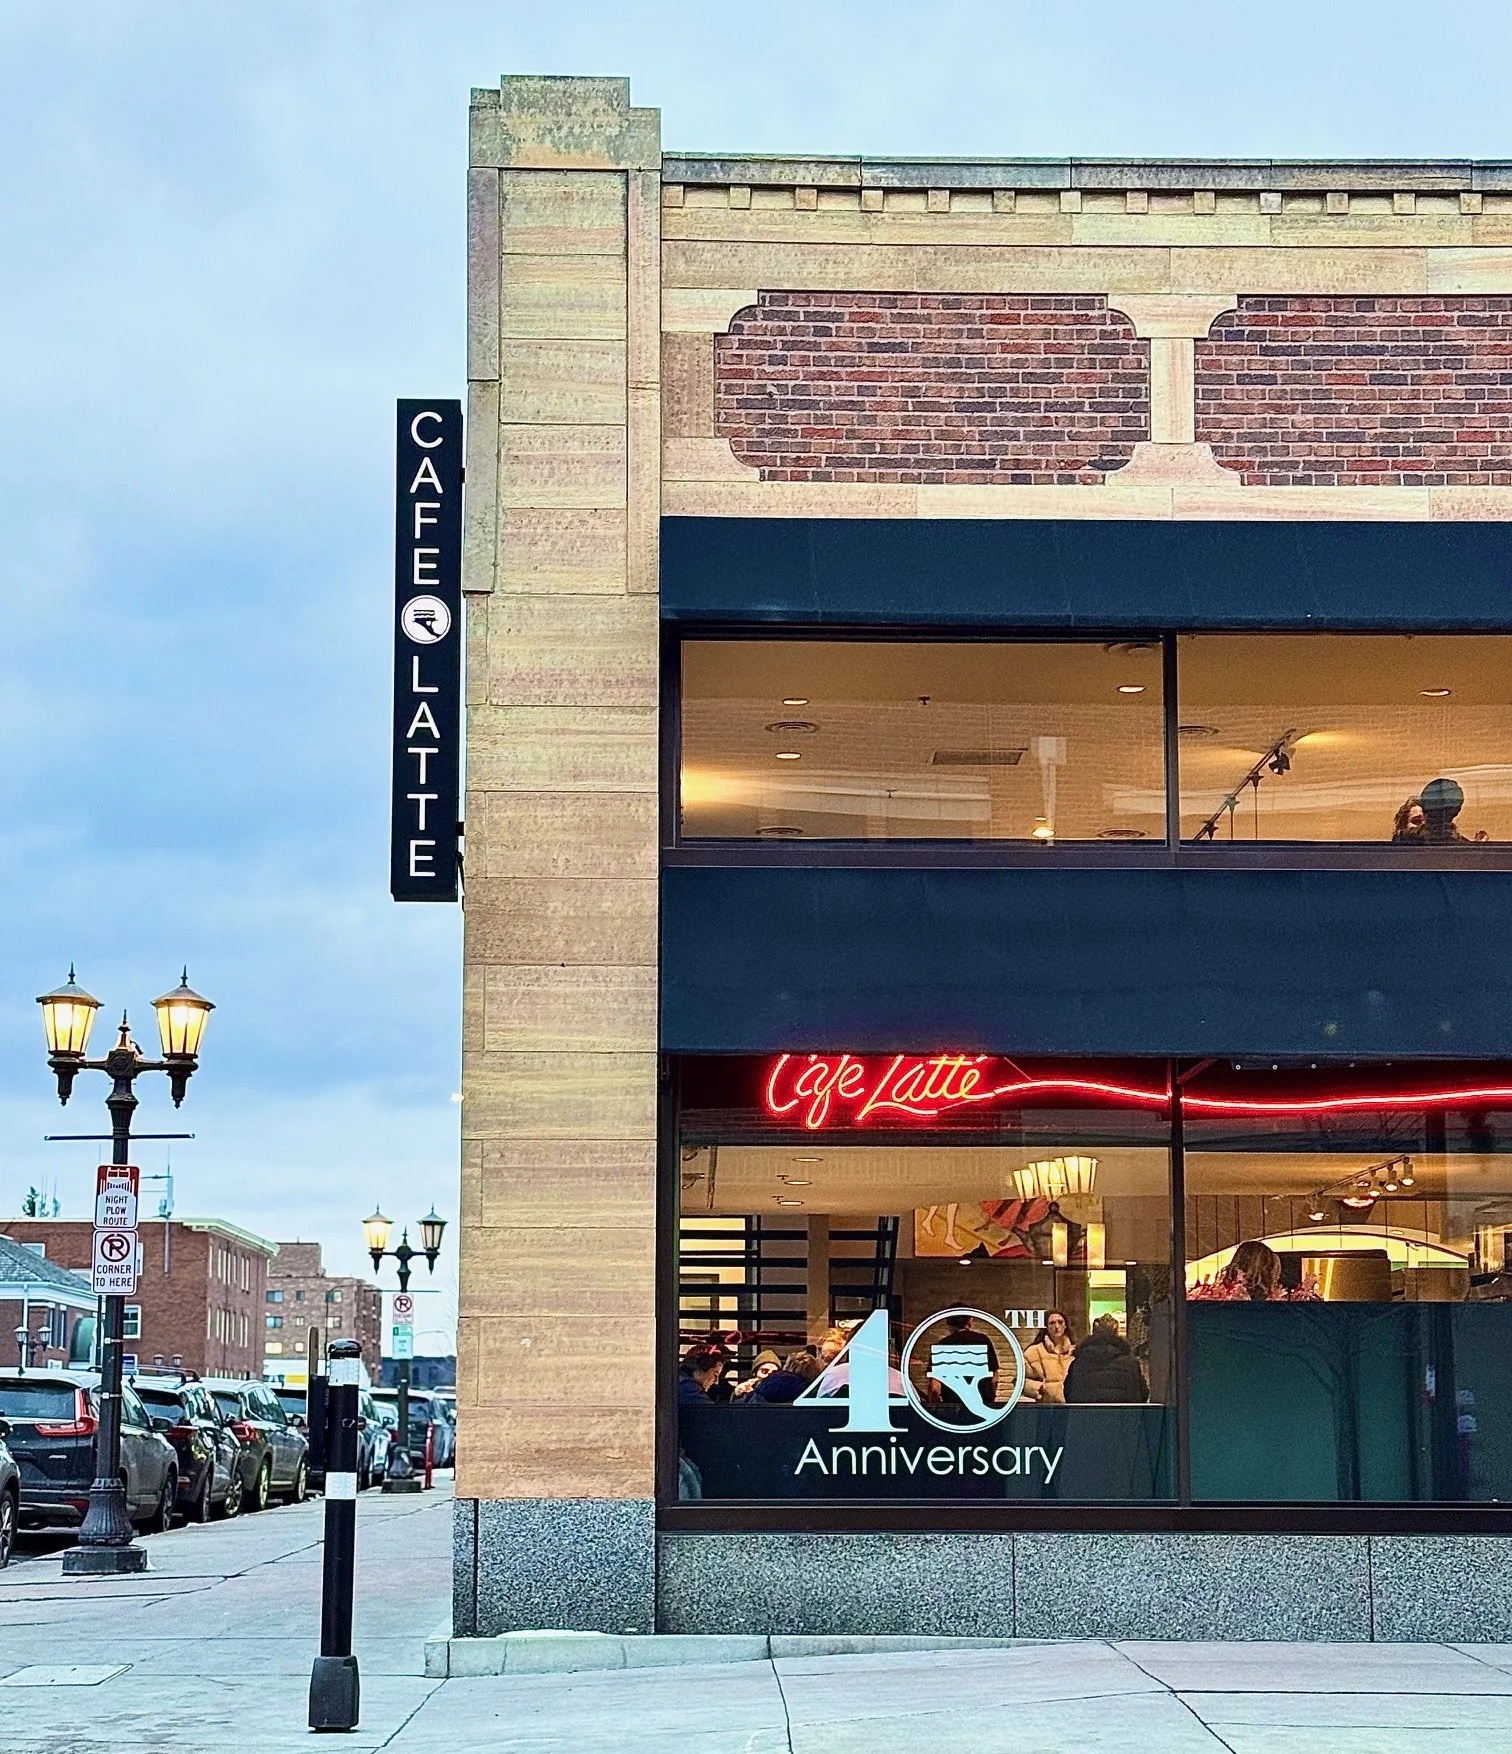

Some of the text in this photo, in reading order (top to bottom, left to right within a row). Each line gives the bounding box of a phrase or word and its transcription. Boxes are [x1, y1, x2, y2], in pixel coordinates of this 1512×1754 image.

[410, 411, 444, 586] CAFE
[406, 655, 441, 878] LATTE
[105, 1195, 129, 1204] NIGHT
[105, 1206, 127, 1215] PLOW
[103, 1217, 128, 1226] ROUTE
[96, 1264, 132, 1274] CORNER
[95, 1277, 132, 1287] TO HERE
[794, 1436, 1064, 1485] Anniversary
